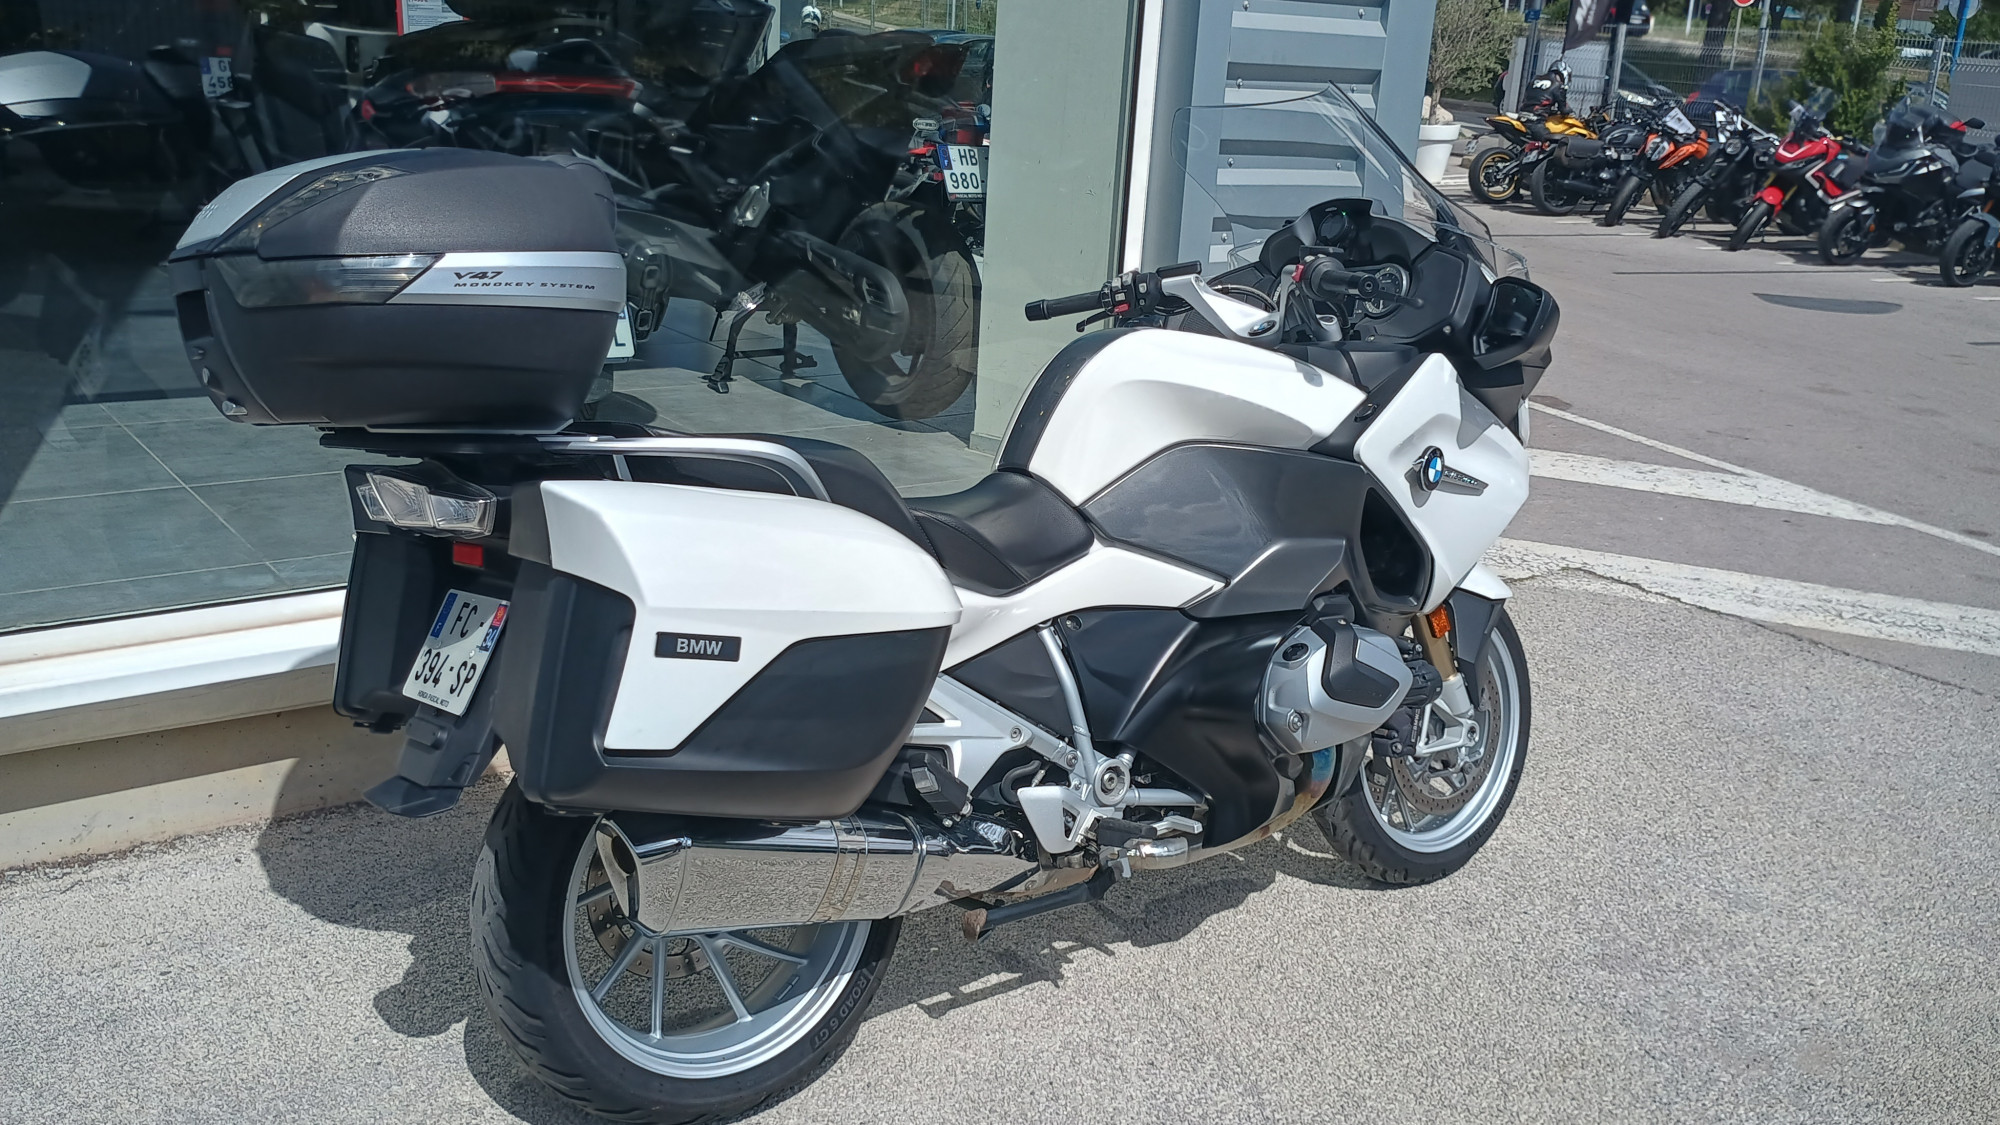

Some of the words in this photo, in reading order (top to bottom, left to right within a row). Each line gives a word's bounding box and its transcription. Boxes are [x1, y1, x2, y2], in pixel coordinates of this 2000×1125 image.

[957, 148, 978, 166] HB
[950, 172, 980, 190] 980
[454, 271, 504, 280] V47
[539, 281, 596, 291] SYSTEM
[676, 638, 723, 656] BMW
[839, 974, 868, 1017] ROAD
[814, 1028, 830, 1049] GT
